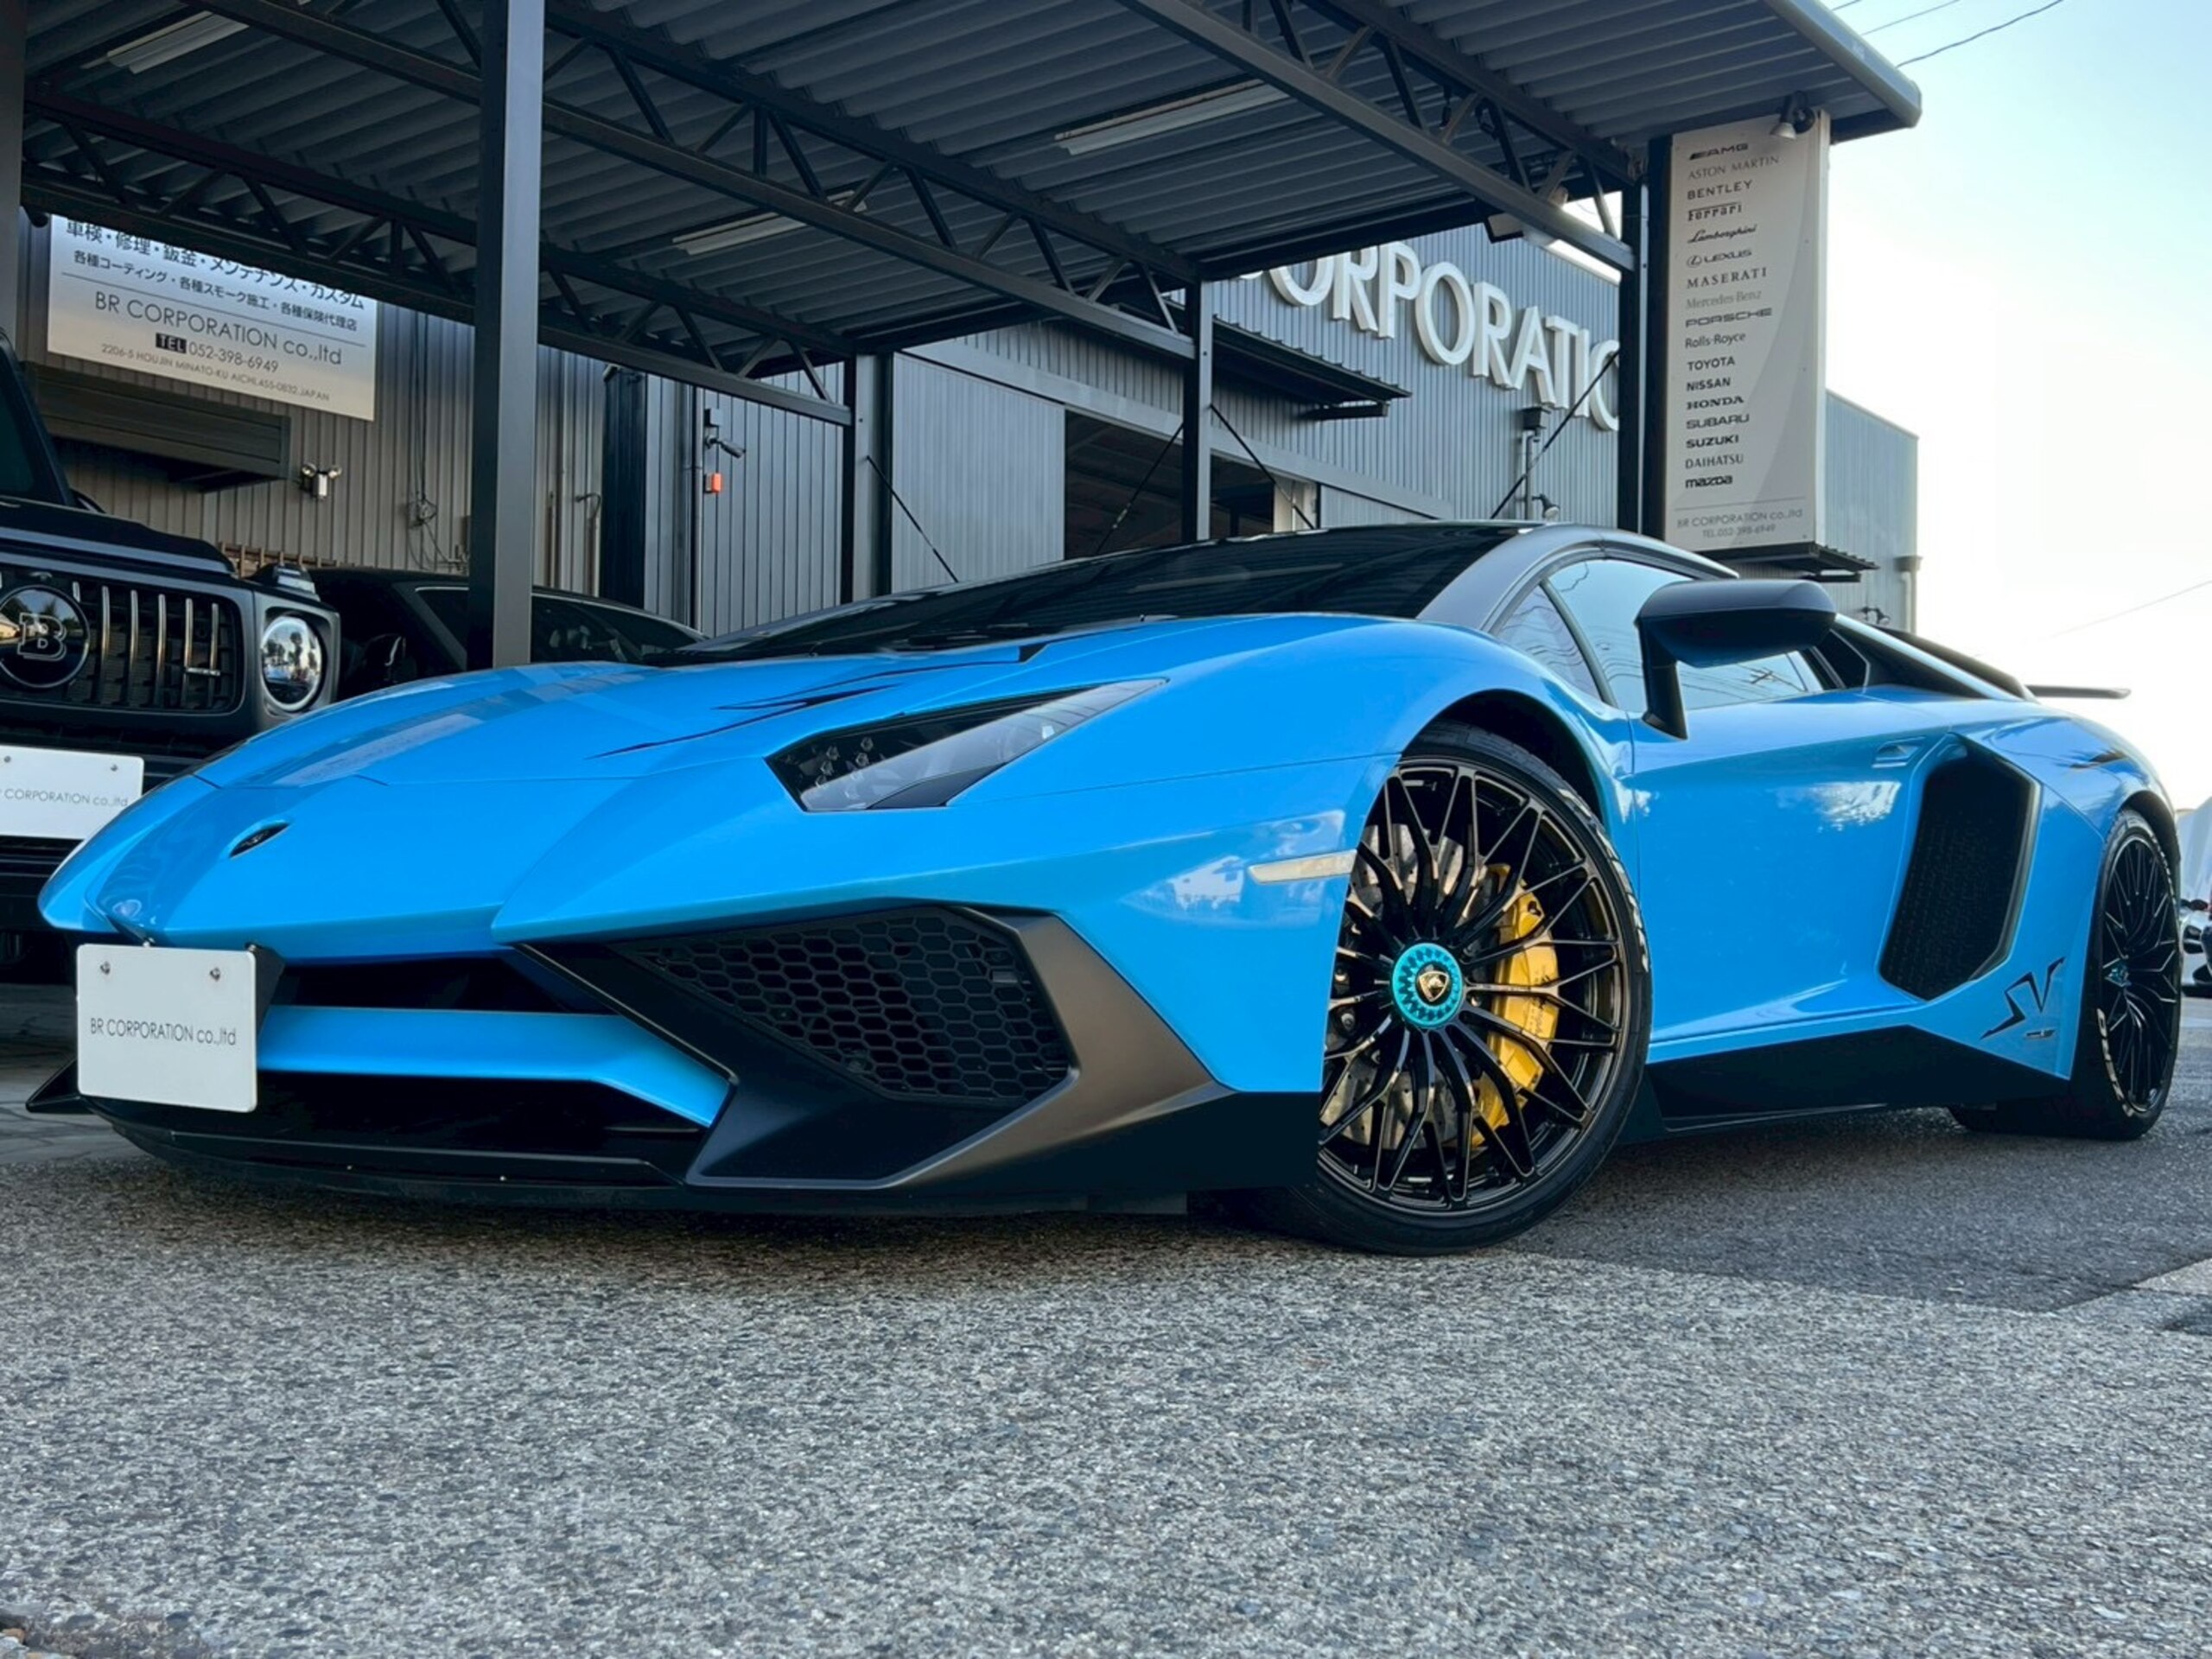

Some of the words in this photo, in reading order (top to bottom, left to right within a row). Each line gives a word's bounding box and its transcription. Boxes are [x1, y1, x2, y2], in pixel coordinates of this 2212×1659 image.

[1705, 143, 1749, 157] AMG
[1688, 165, 1726, 180] ASTON
[1731, 156, 1780, 171] MARTIN
[1688, 180, 1753, 200] BENTLEY
[1688, 201, 1743, 221] Ferrari
[1688, 224, 1758, 243] Lamborghini
[1703, 249, 1752, 264] LEXUS
[1688, 266, 1768, 289] MASERATI
[96, 290, 119, 313] BR
[127, 299, 277, 350] CORPORATION
[1686, 308, 1772, 328] PORSCHE
[156, 333, 187, 353] TEL
[188, 341, 279, 372] 052-398-6949
[1688, 356, 1735, 371] TOYOTA
[1687, 378, 1731, 391] NISSAN
[1687, 396, 1745, 410] HONDA
[1686, 413, 1750, 429] SUBARU
[1686, 435, 1739, 448] SUZUKI
[1685, 454, 1744, 469] DAIHATSU
[1685, 475, 1733, 489] mazda
[4, 788, 90, 804] CORPORATION
[91, 1017, 105, 1035] BR
[106, 1019, 194, 1043] CORPORATION
